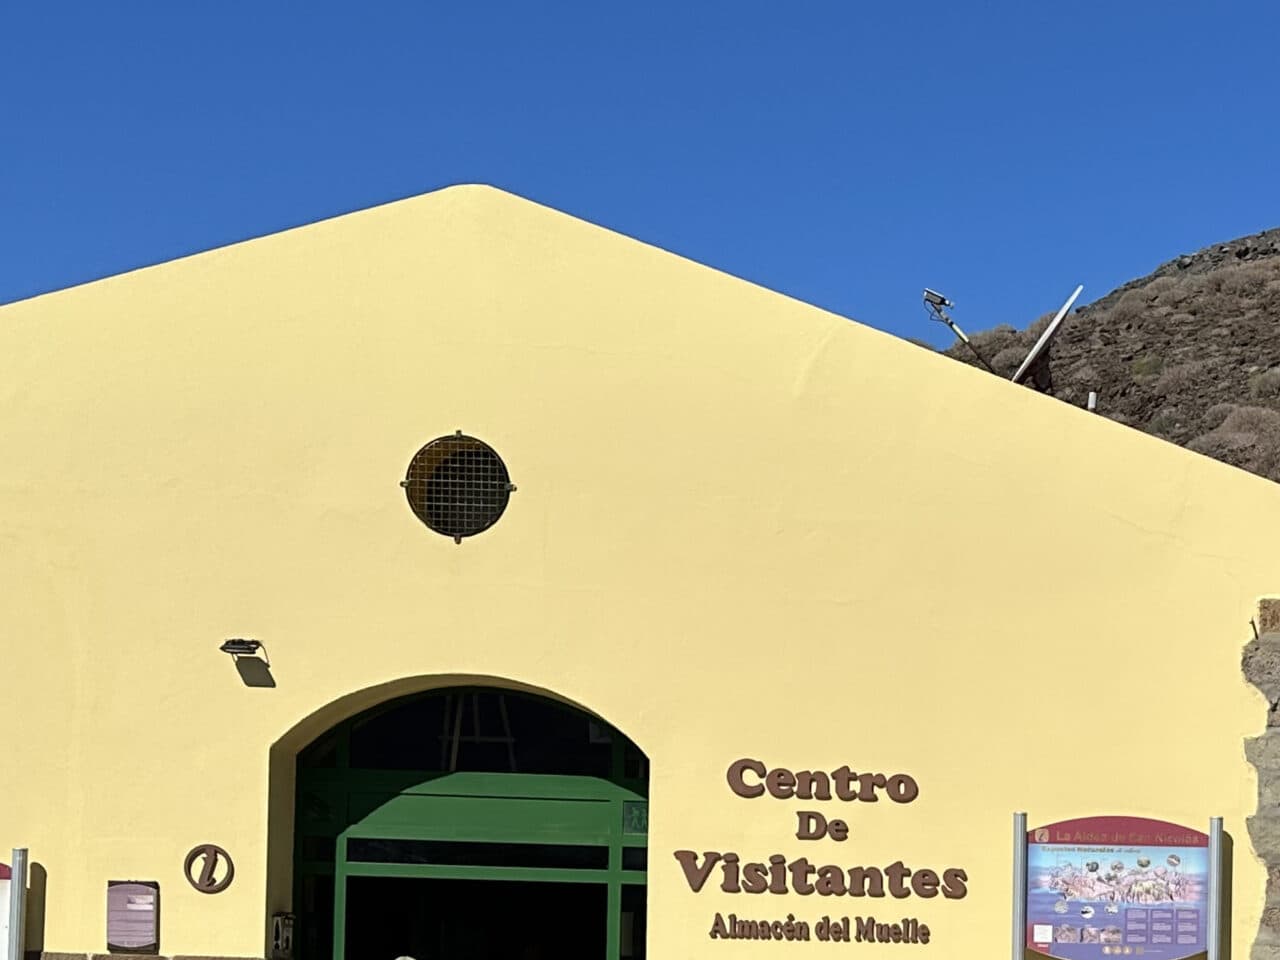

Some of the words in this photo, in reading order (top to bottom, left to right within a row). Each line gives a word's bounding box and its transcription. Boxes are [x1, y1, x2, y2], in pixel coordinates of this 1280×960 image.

[727, 759, 919, 804] Centro
[796, 811, 849, 842] De
[674, 850, 968, 899] Visitantes
[709, 913, 810, 941] Almacén
[815, 916, 850, 942] del
[855, 917, 930, 944] Muelle
